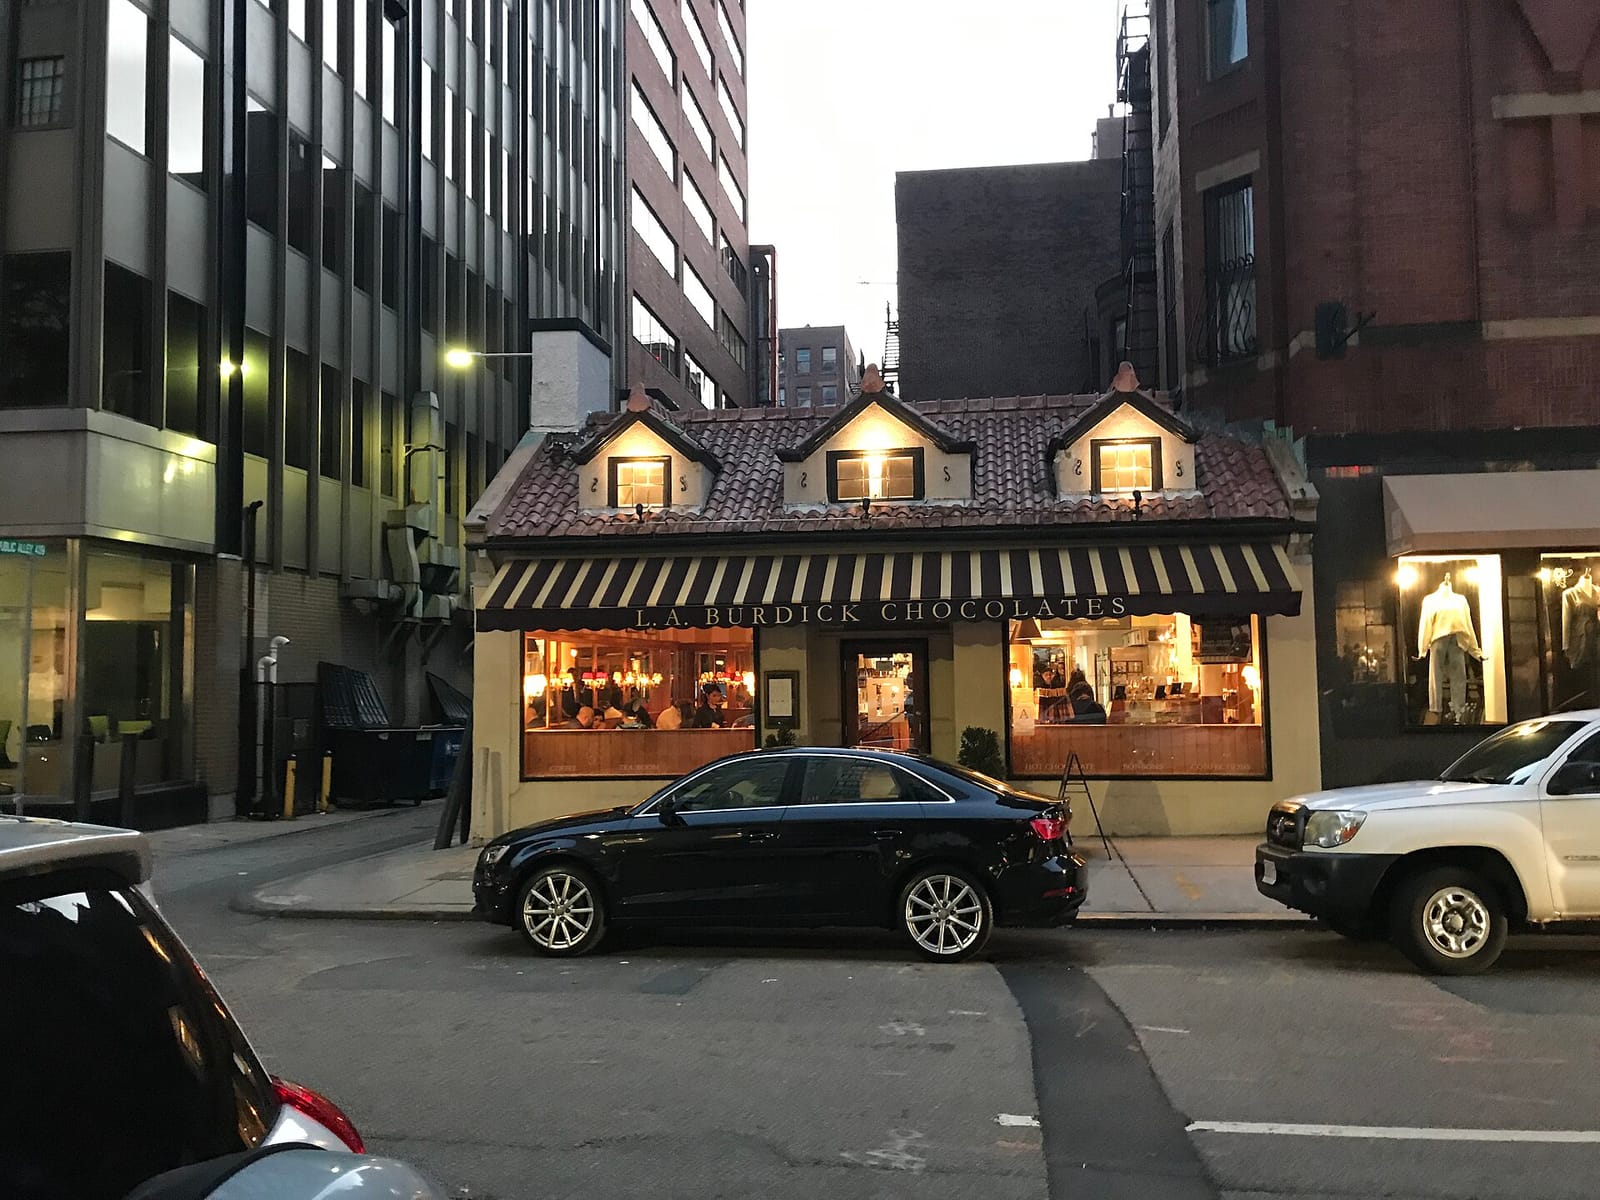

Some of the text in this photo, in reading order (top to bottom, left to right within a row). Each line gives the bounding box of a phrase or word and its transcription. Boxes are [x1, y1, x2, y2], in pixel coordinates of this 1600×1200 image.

[17, 543, 34, 555] ALLEY
[704, 604, 861, 626] BURDICK
[881, 597, 1126, 621] CHOCOLATES
